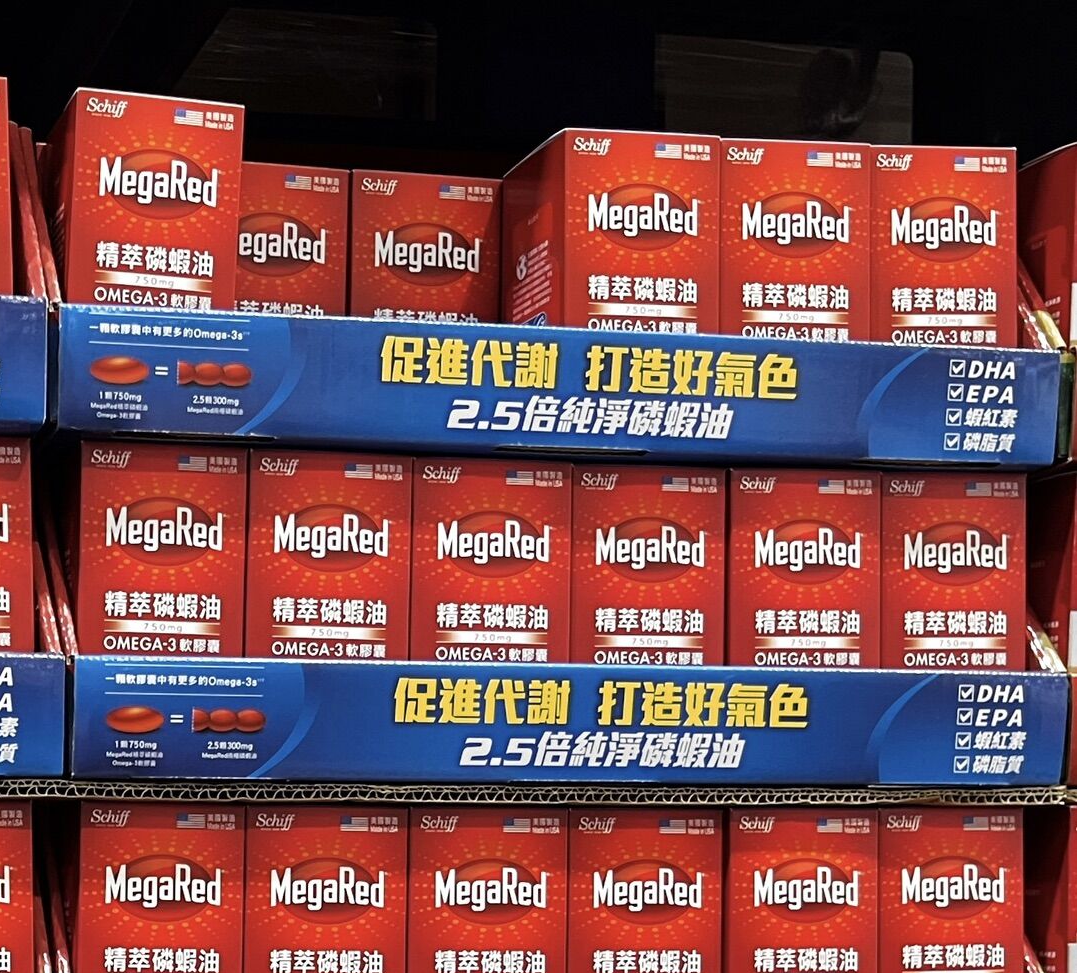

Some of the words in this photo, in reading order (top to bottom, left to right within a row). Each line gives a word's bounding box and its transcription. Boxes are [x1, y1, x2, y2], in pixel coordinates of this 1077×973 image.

[87, 98, 127, 118] Schiff
[727, 148, 764, 164] Schiff
[100, 157, 218, 207] MegaRed
[589, 193, 697, 236] MegaRed
[743, 201, 849, 244] MegaRed
[892, 206, 996, 248] MegaRed
[96, 241, 213, 276] 精萃磷蝦油
[238, 220, 326, 264] egaRed
[375, 231, 479, 273] MegaRed
[892, 287, 996, 312] 精萃磷蝦油
[381, 336, 558, 389] 促進代謝
[583, 345, 797, 402] 打造好氣色
[968, 361, 1015, 379] DHA
[966, 385, 1013, 404] EPA
[447, 395, 734, 439] 2.5倍純淨磷蝦油
[964, 408, 1018, 428] 蝦紅素
[963, 433, 1015, 452] 磷脂質
[581, 473, 619, 490] Schiff
[106, 507, 223, 551] MegaRed
[275, 514, 388, 557] MegaRed
[438, 520, 549, 563] MegaRed
[596, 526, 704, 569] MegaRed
[756, 528, 860, 570] MegaRed
[905, 530, 1006, 572] MegaRed
[273, 597, 386, 624] 精萃磷蝦油
[756, 610, 860, 634] 精萃磷蝦油
[394, 678, 570, 724] 促進代謝
[598, 681, 807, 727] 打造好氣色
[977, 685, 1024, 703] DHA
[975, 709, 1022, 727] EPA
[460, 731, 745, 768] 2.5倍純淨磷蝦油
[973, 731, 1026, 750] 蝦紅素
[972, 755, 1024, 773] 磷脂質
[420, 816, 459, 832] Schiff
[106, 864, 221, 907] MegaRed
[271, 867, 384, 910] MegaRed
[436, 868, 546, 910] MegaRed
[594, 868, 701, 911] MegaRed
[755, 867, 858, 909] MegaRed
[902, 864, 1004, 906] MegaRed
[104, 947, 219, 973] 精萃磷蝦油
[594, 950, 701, 973] 精萃磷蝦油
